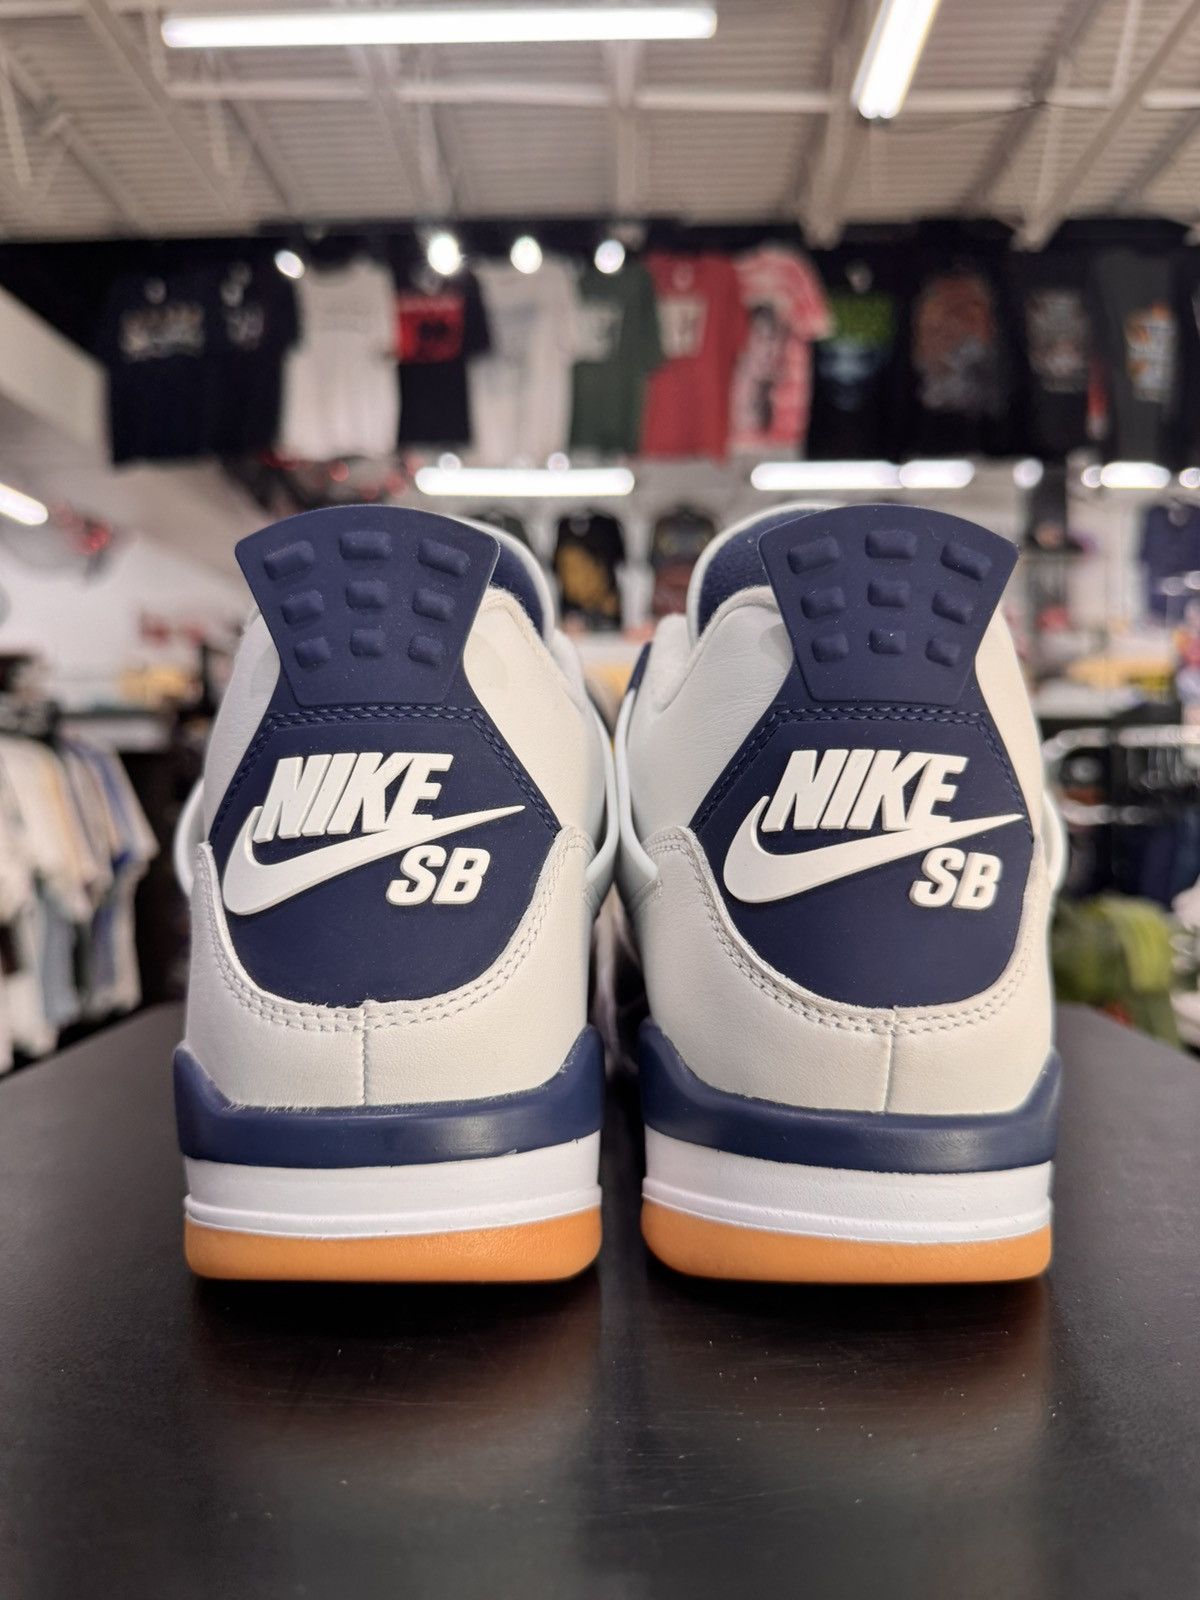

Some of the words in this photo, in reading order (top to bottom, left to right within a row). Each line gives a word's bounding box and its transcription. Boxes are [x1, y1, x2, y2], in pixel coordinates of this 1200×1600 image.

[253, 752, 453, 843] NIKE
[761, 749, 968, 832] NIKE
[386, 845, 490, 906] SB
[909, 847, 1001, 910] SB
